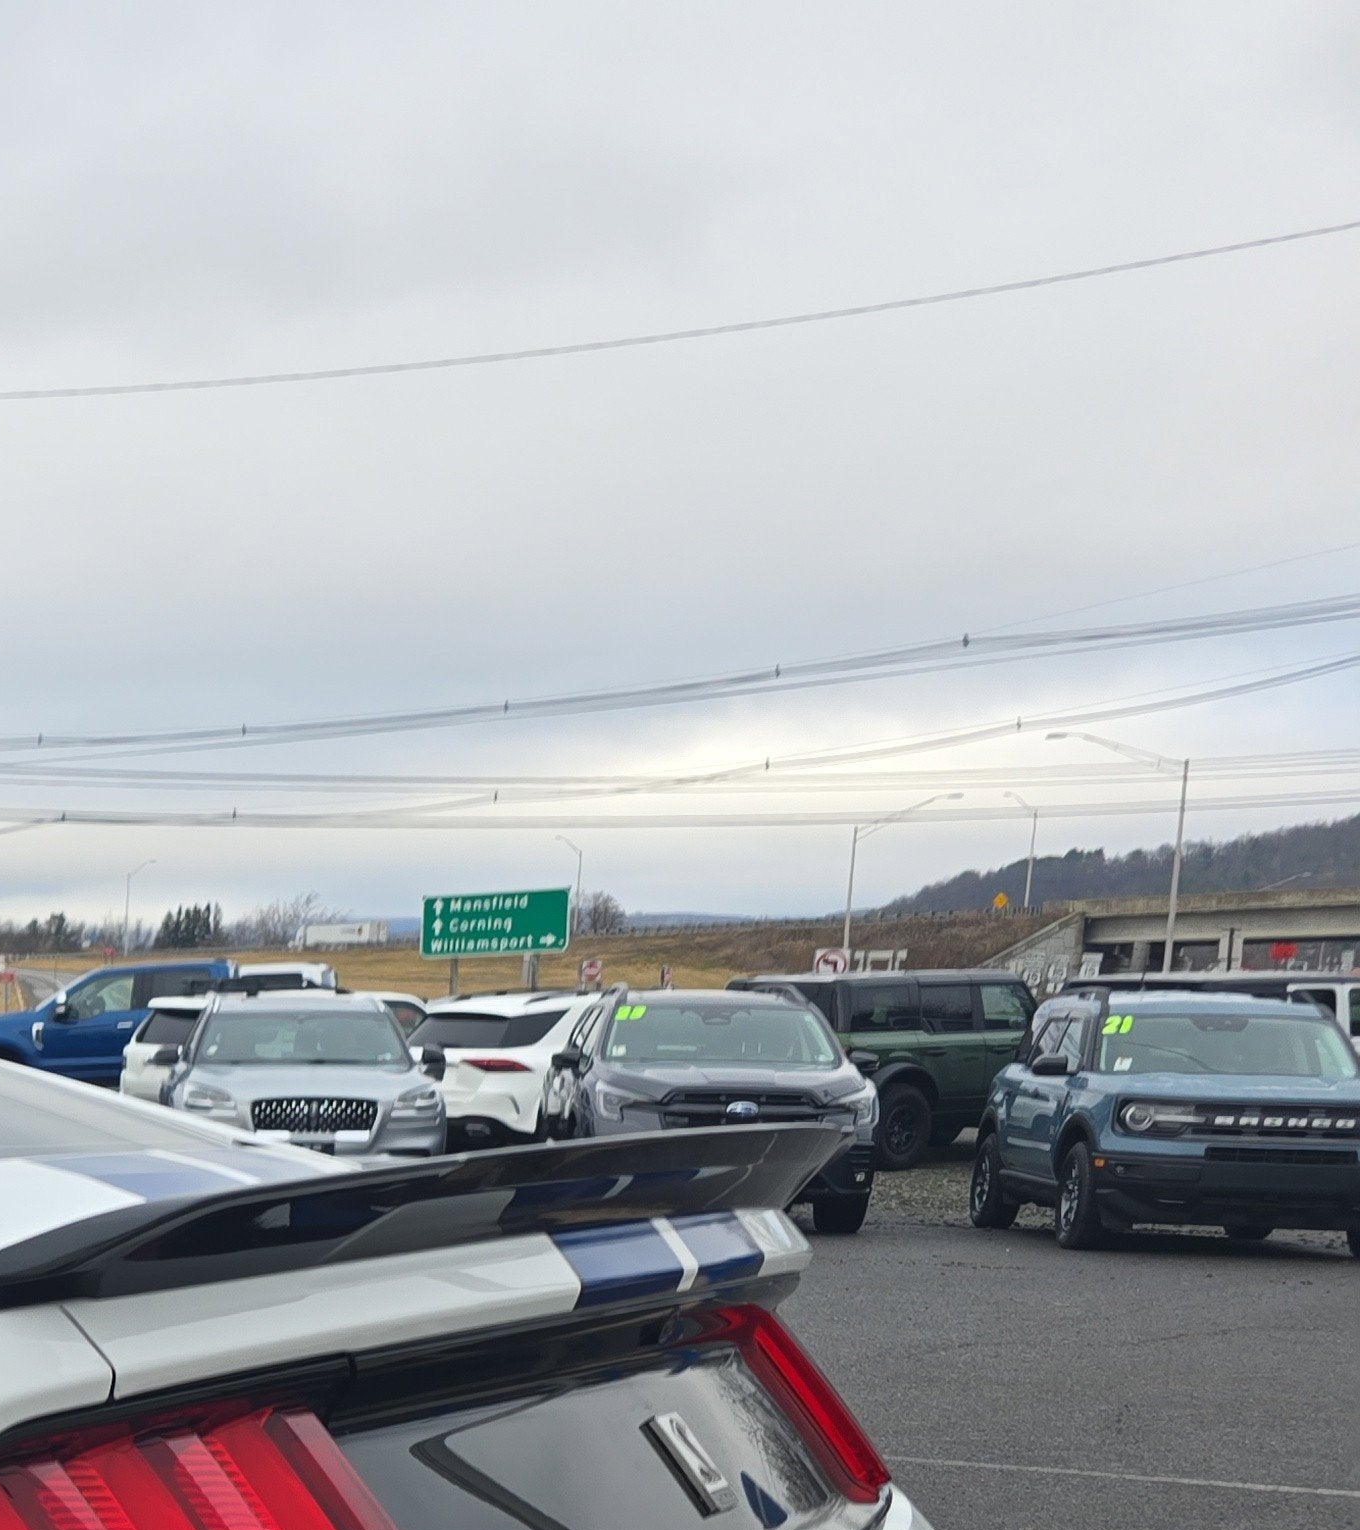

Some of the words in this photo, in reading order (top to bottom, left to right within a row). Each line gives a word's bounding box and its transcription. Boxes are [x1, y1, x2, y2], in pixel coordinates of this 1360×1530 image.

[449, 894, 529, 913] Mansfield
[449, 916, 513, 934] Corning
[430, 934, 533, 952] Williamsport
[1101, 1014, 1134, 1036] 21
[1214, 1115, 1357, 1129] BRONCO
